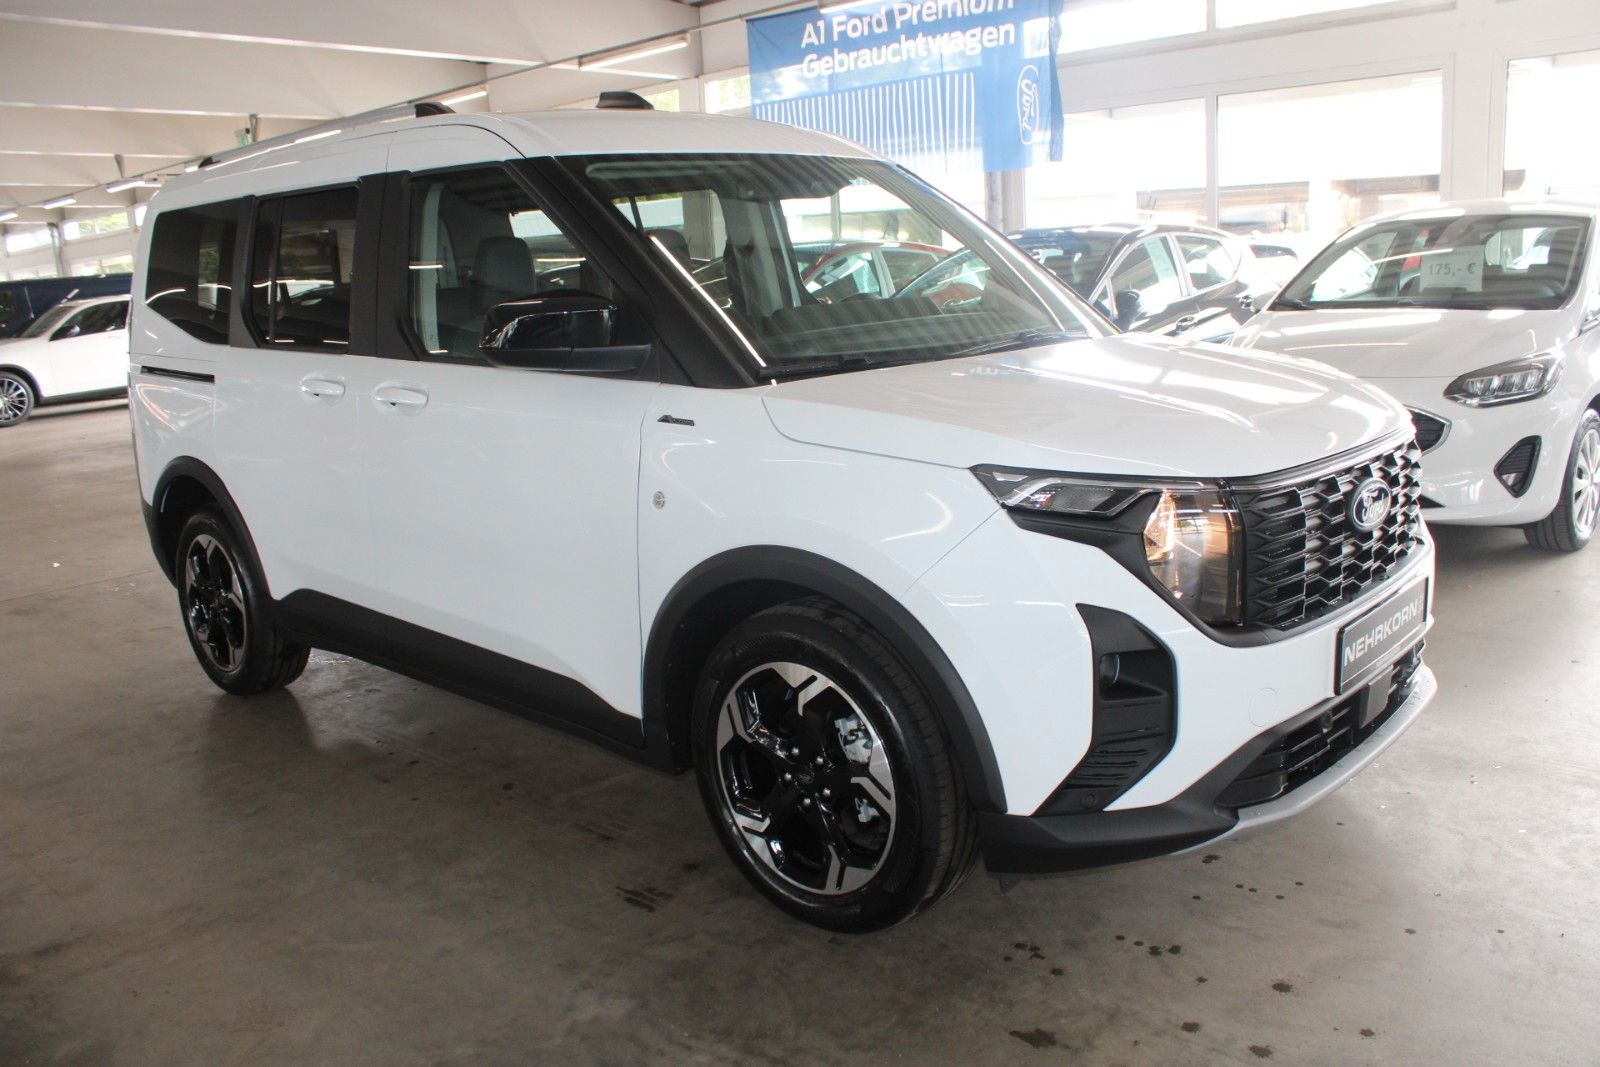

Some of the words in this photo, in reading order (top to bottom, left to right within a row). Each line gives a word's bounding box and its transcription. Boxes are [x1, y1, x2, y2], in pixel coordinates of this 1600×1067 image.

[801, 20, 825, 48] A1
[832, 6, 888, 41] Ford
[803, 23, 1015, 78] Gebrauchtwagen
[1021, 79, 1038, 131] Ford
[1467, 262, 1477, 274] €
[1360, 489, 1385, 521] Ford
[1344, 599, 1418, 667] NEHRKORN
